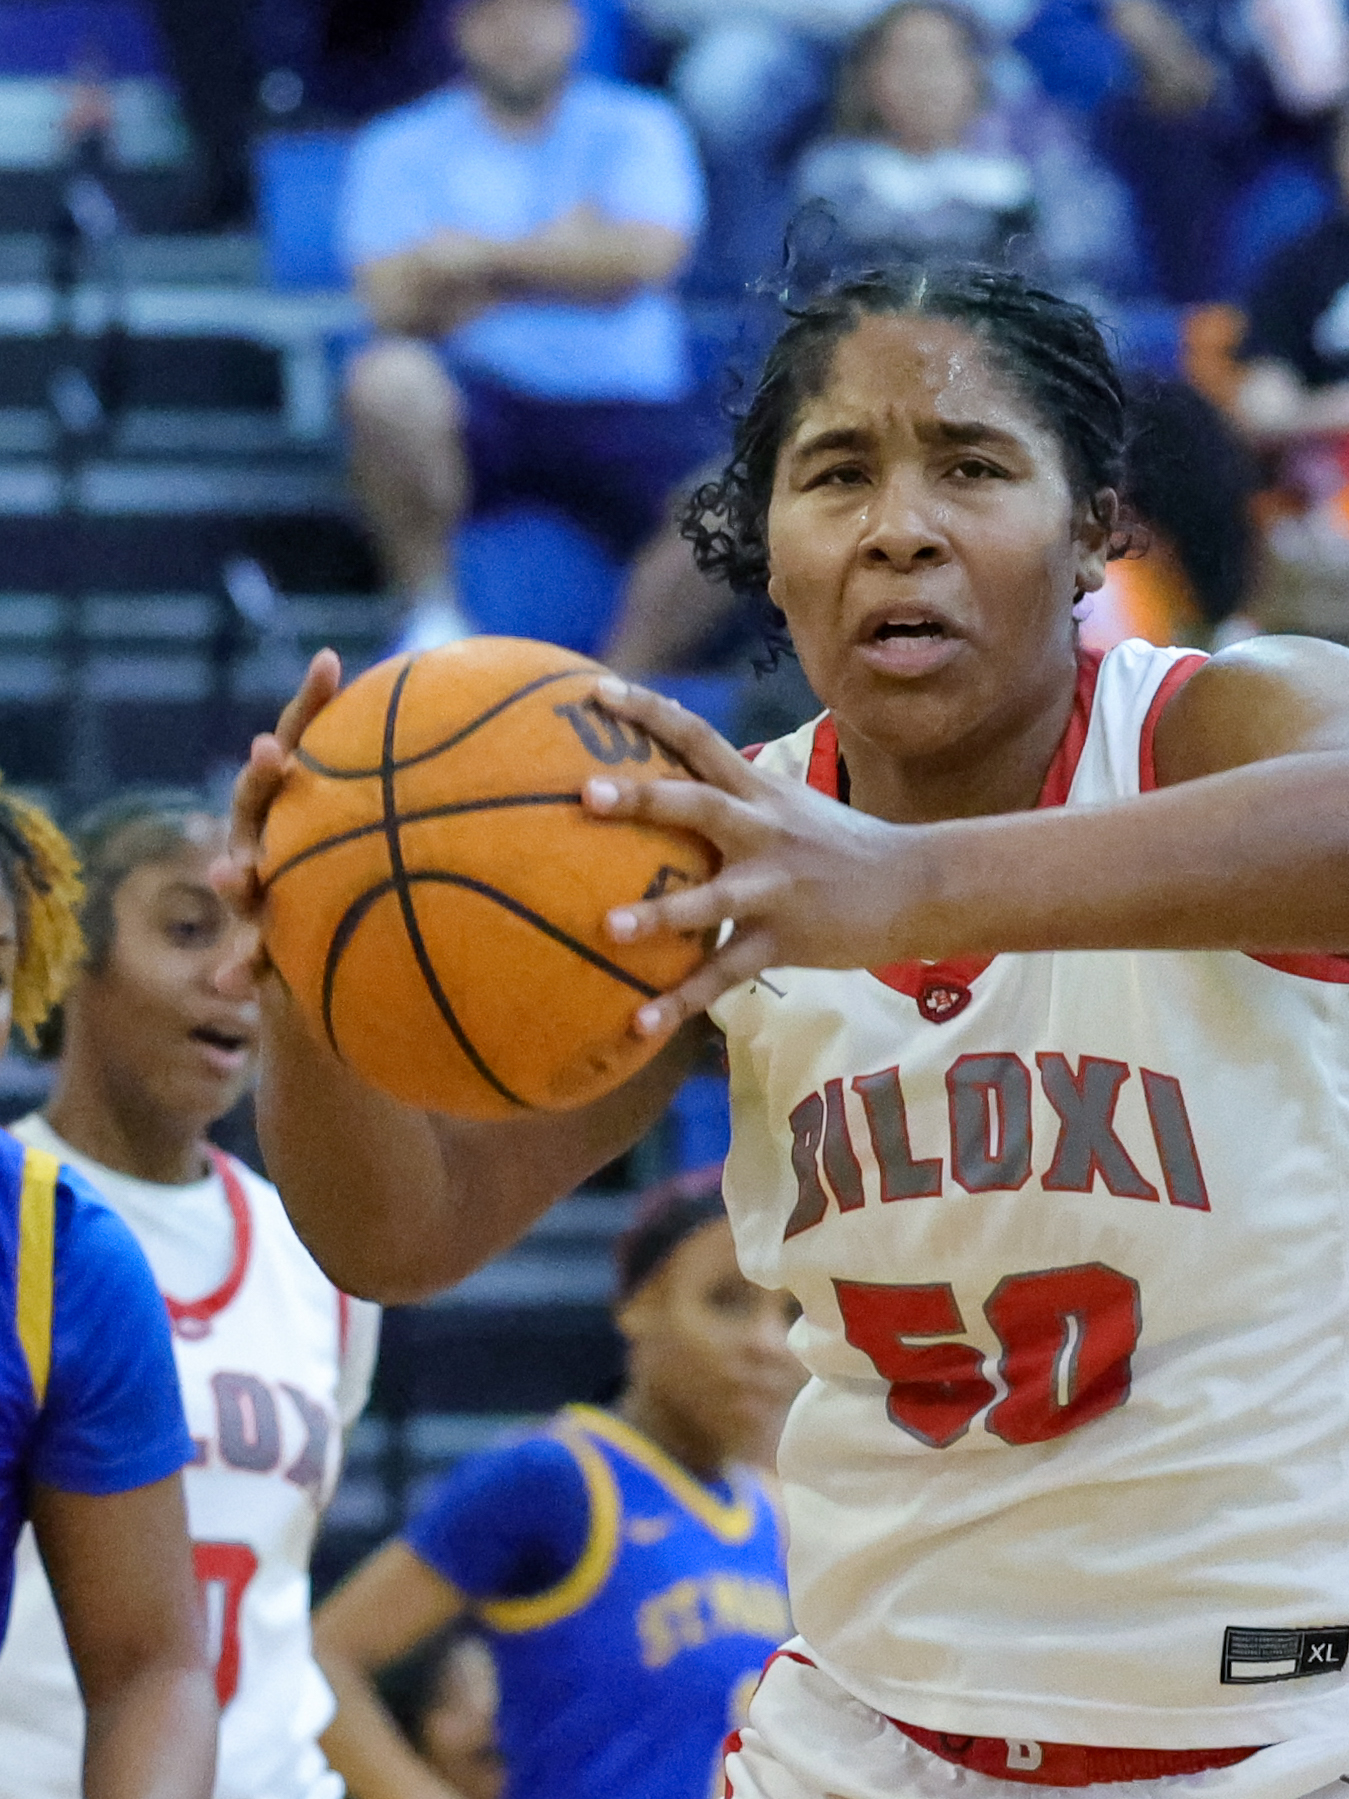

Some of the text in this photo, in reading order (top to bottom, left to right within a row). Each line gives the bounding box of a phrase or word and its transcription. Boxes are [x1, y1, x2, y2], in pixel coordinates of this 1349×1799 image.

[783, 1052, 1211, 1244] BILOXI
[831, 1261, 1143, 1449] 50
[1307, 1643, 1340, 1663] XL
